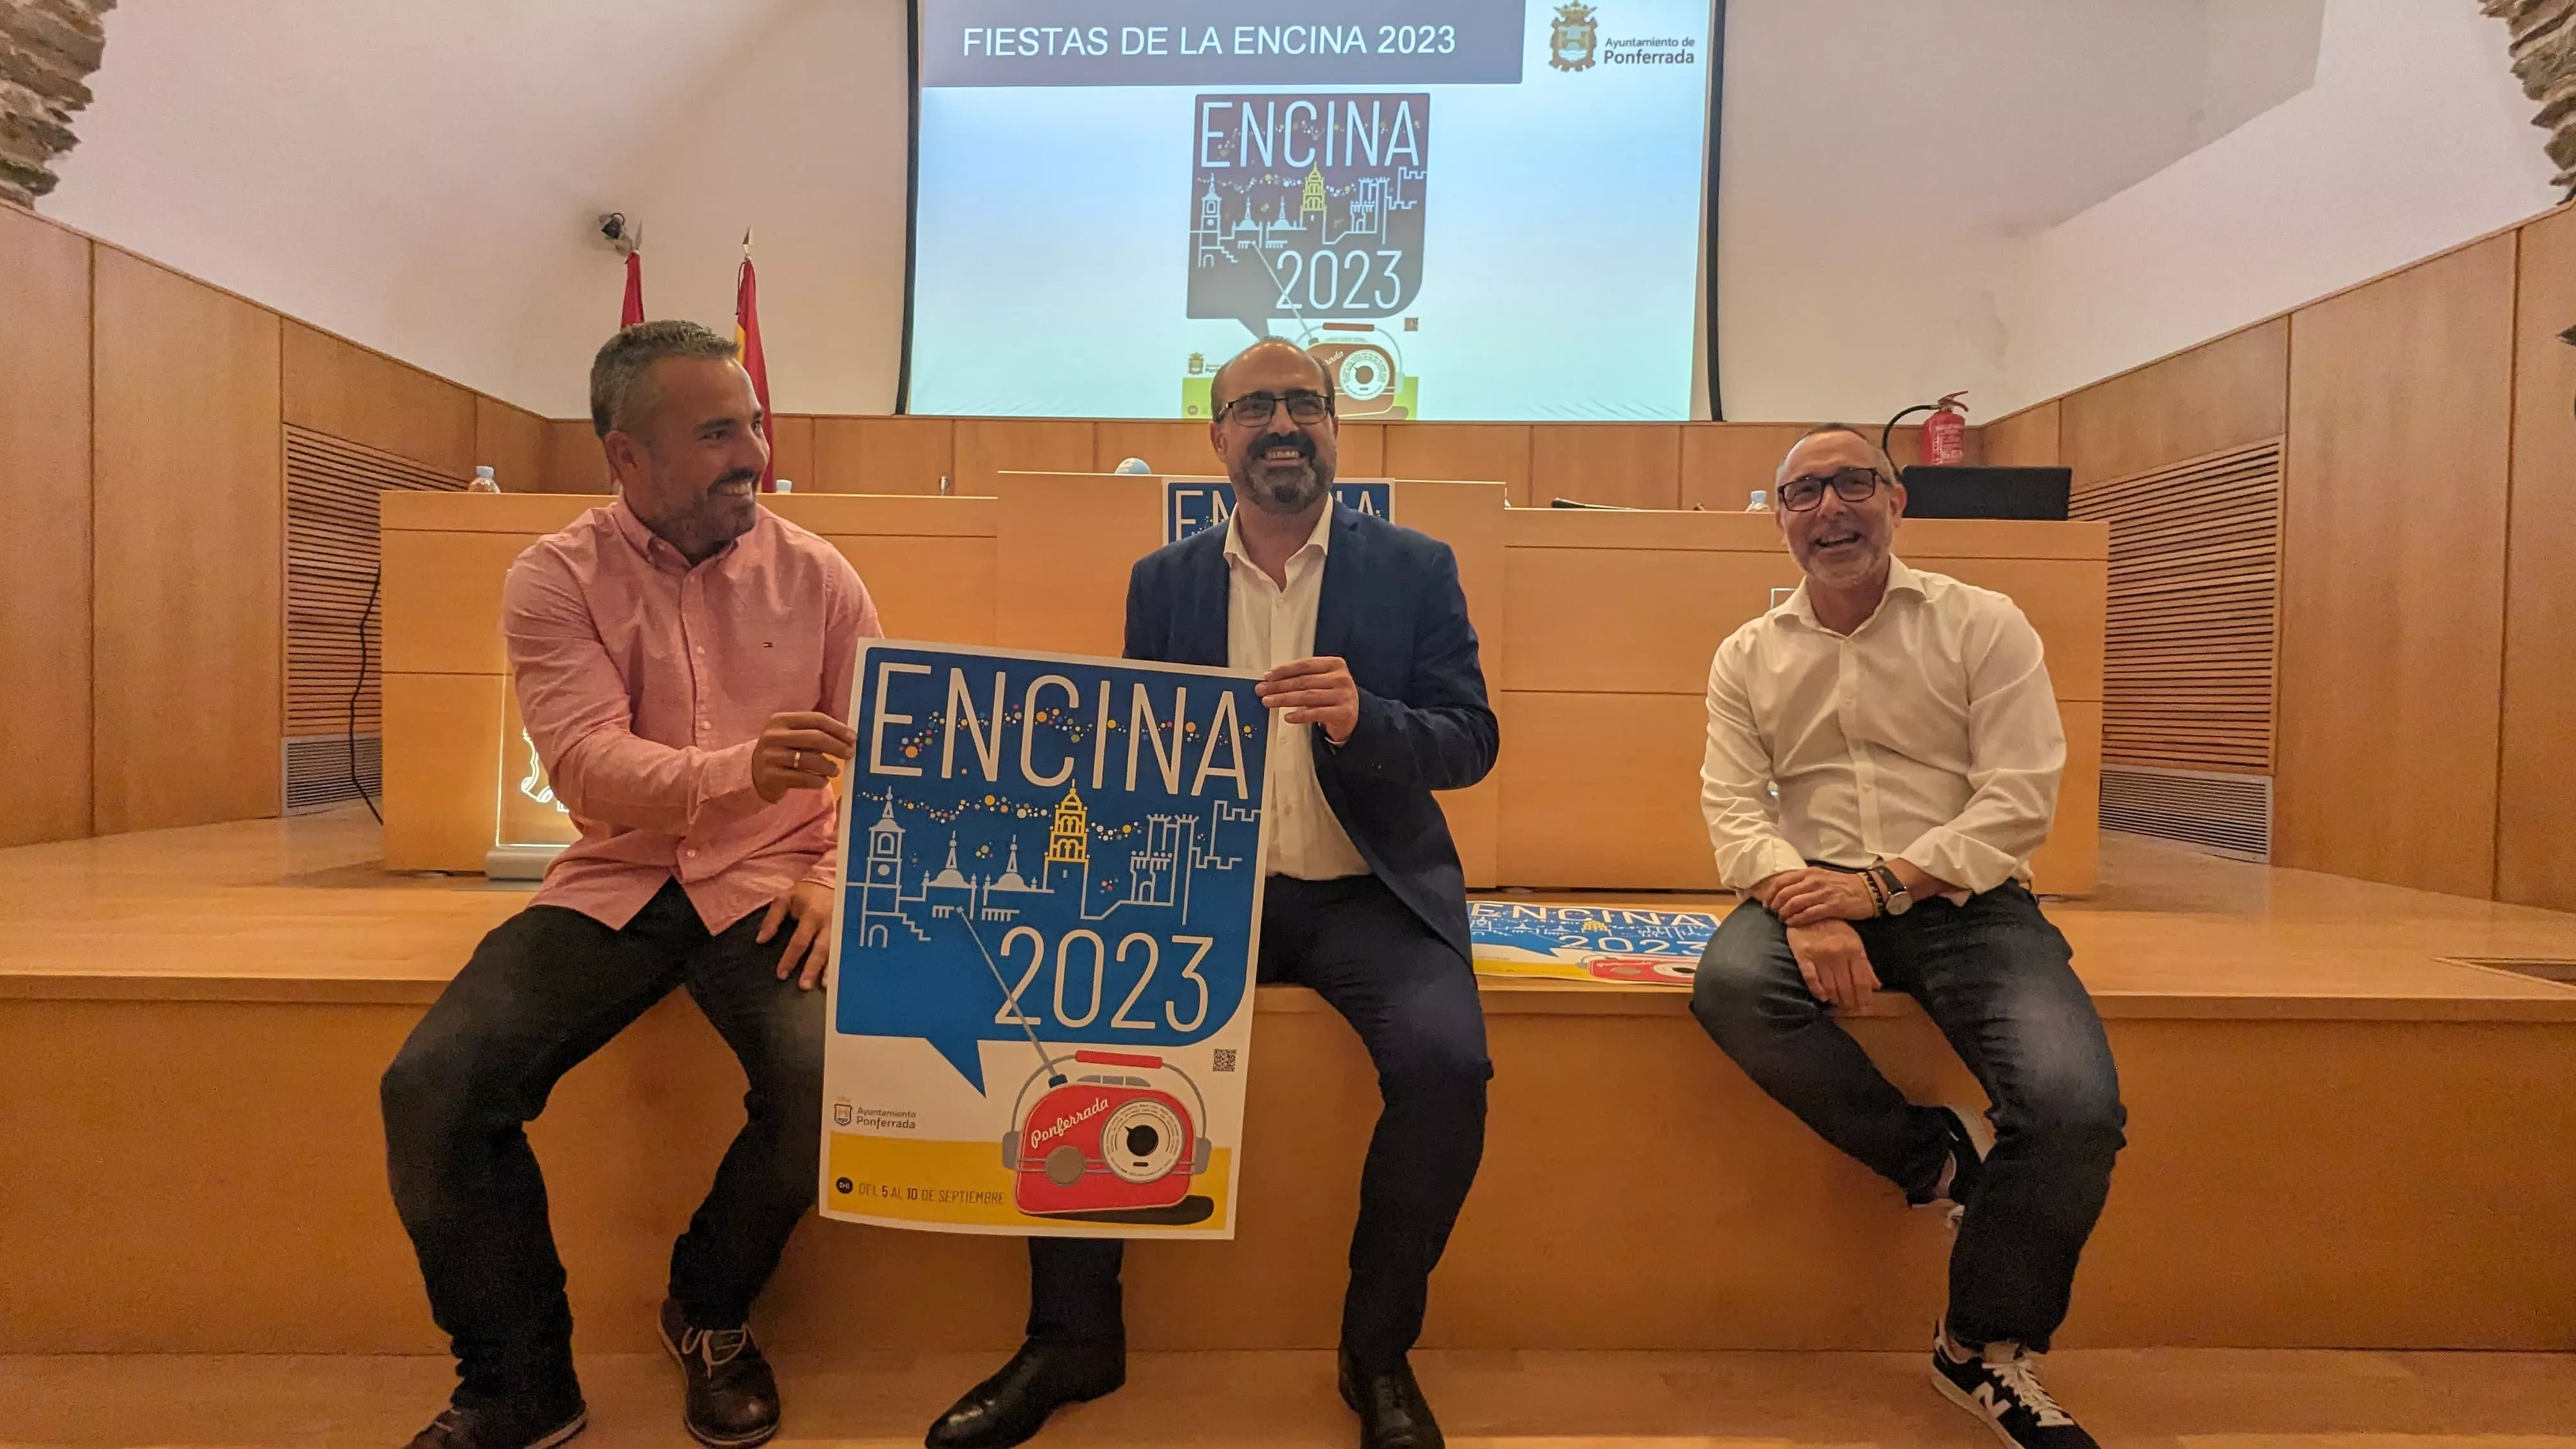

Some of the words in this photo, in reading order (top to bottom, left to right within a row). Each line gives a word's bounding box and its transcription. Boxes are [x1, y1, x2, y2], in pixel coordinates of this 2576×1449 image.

[963, 27, 1108, 56] FIESTAS
[1121, 27, 1168, 55] DE
[1181, 26, 1222, 54] LA
[1234, 26, 1367, 54] ENCINA
[1377, 25, 1455, 54] 2023
[1605, 37, 1678, 49] Ayuntamiento
[1682, 37, 1695, 47] de
[1604, 49, 1694, 64] Ponferrada
[1200, 100, 1419, 167] ENCINA
[1276, 250, 1402, 309] 2023
[870, 661, 1248, 799] ENCINA
[1471, 903, 1710, 929] ENCINA
[995, 926, 1213, 1032] 2023
[857, 1107, 916, 1118] Ayuntamiento
[857, 1116, 916, 1130] Ponferrada
[1031, 1098, 1109, 1149] Ponferrada
[859, 1182, 878, 1197] DEL
[882, 1185, 888, 1197] 5
[891, 1186, 902, 1198] AL
[907, 1188, 917, 1200] 10
[922, 1189, 934, 1201] DE
[939, 1191, 1005, 1204] SEPTIEMBRE
